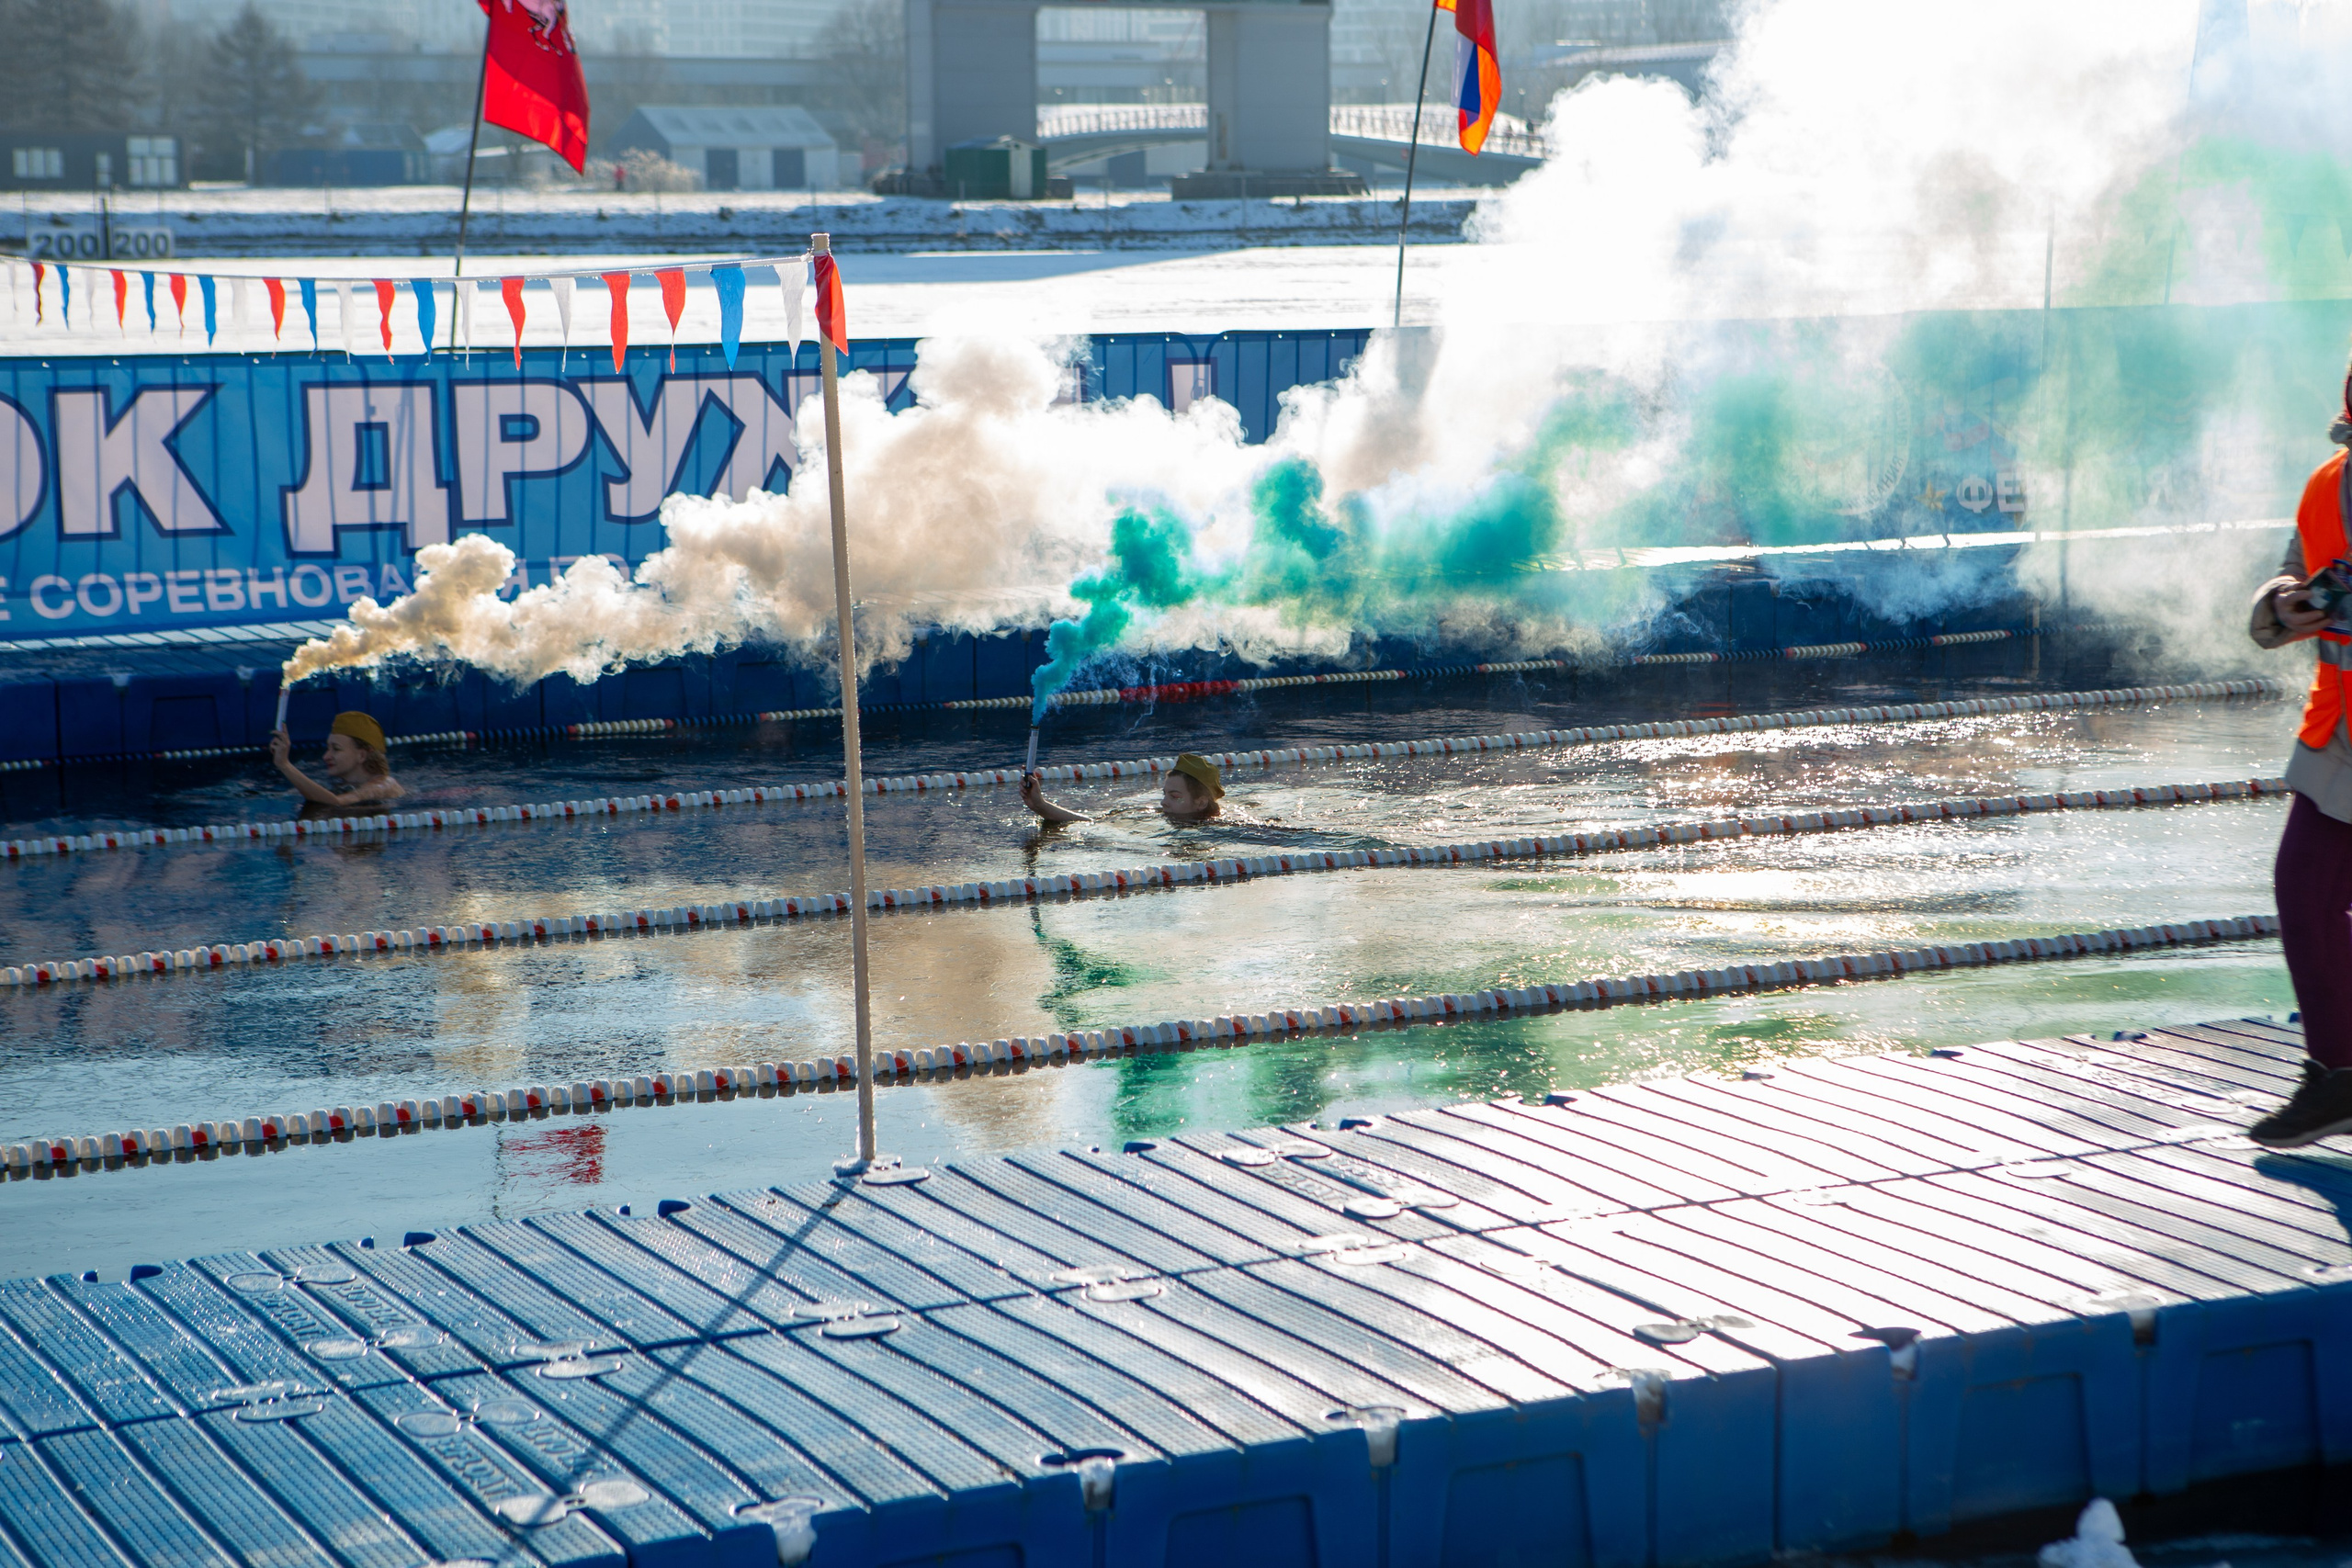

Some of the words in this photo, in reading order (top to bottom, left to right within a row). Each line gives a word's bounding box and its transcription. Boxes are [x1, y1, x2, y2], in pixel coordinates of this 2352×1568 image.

[33, 233, 97, 259] 200
[115, 232, 169, 258] 200
[29, 557, 531, 621] СОРЕВНОВАЯ
